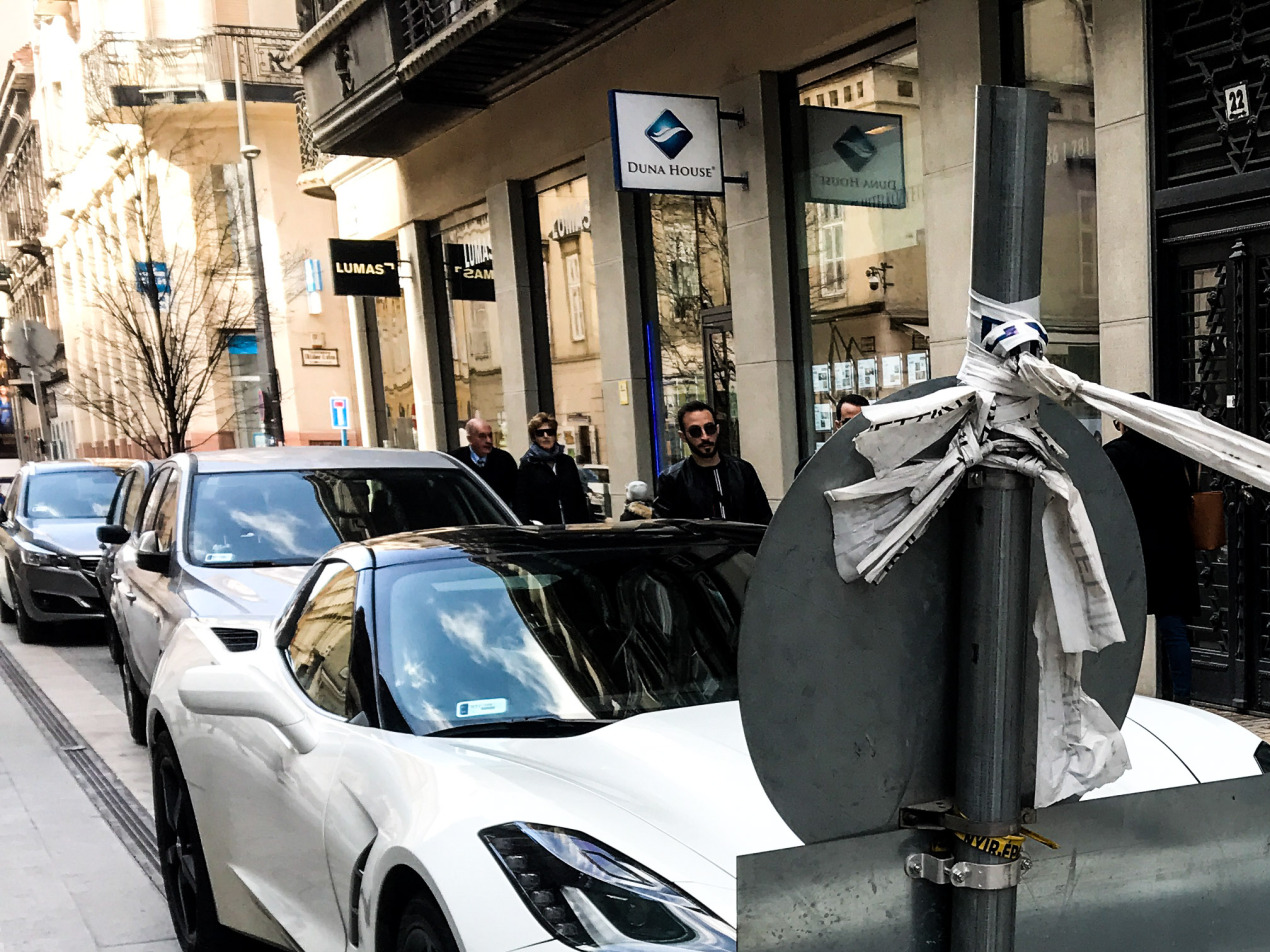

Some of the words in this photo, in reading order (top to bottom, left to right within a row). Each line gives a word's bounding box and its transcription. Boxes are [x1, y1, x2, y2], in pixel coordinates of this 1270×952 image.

[1229, 89, 1245, 112] 22
[627, 161, 665, 175] DUNA
[335, 261, 385, 275] LUMAS
